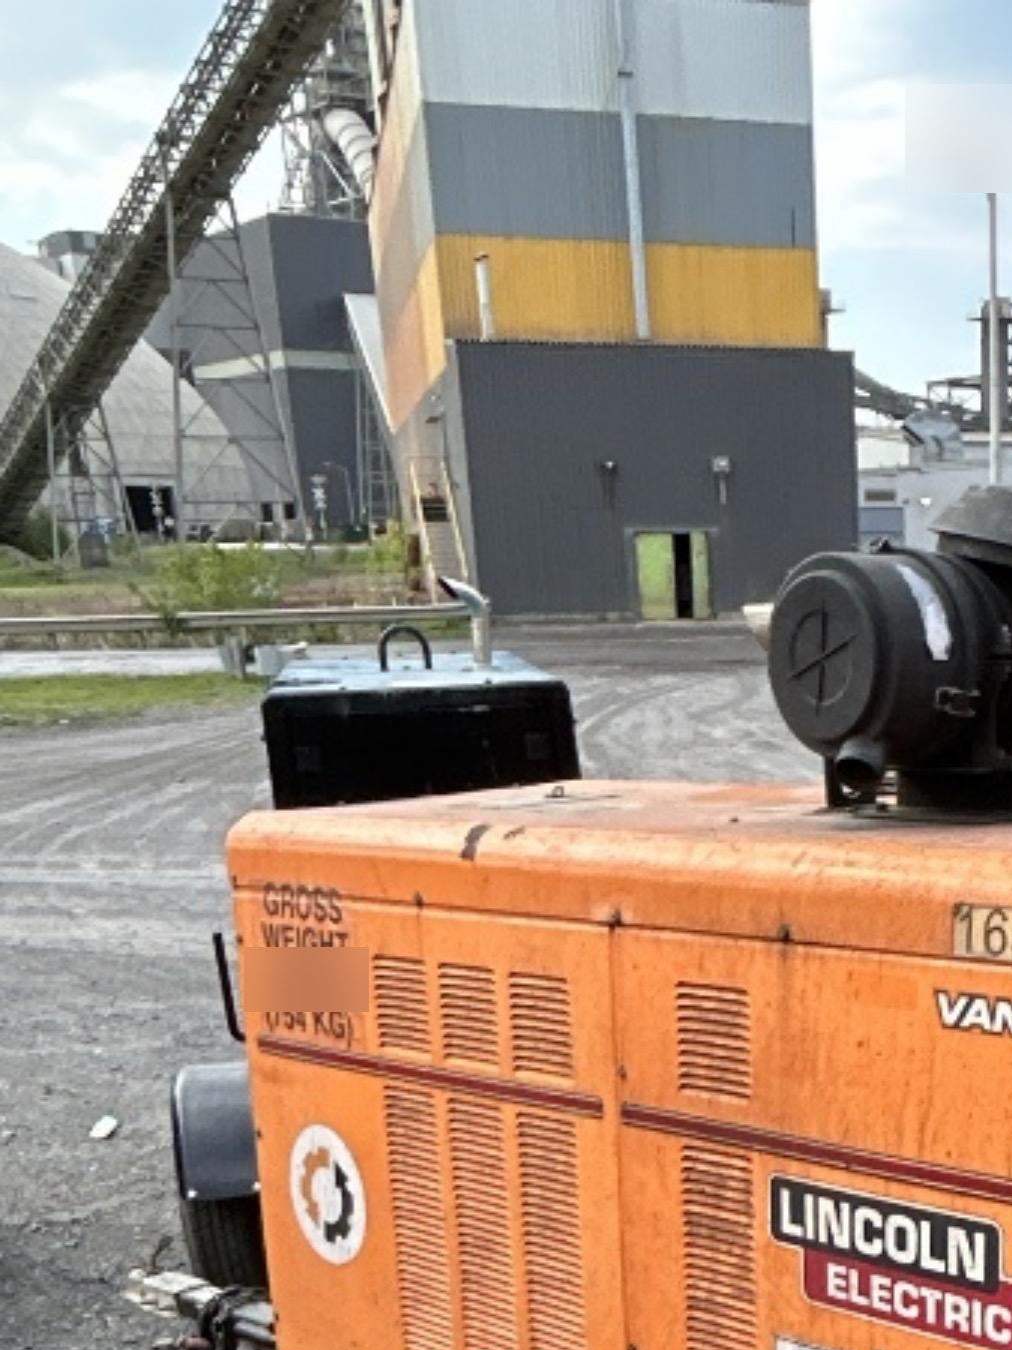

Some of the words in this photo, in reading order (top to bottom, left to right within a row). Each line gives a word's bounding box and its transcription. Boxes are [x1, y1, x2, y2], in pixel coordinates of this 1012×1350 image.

[262, 881, 343, 924] GROSS
[777, 1193, 988, 1282] LINCOLN
[825, 1263, 1012, 1345] ELECTRIC
